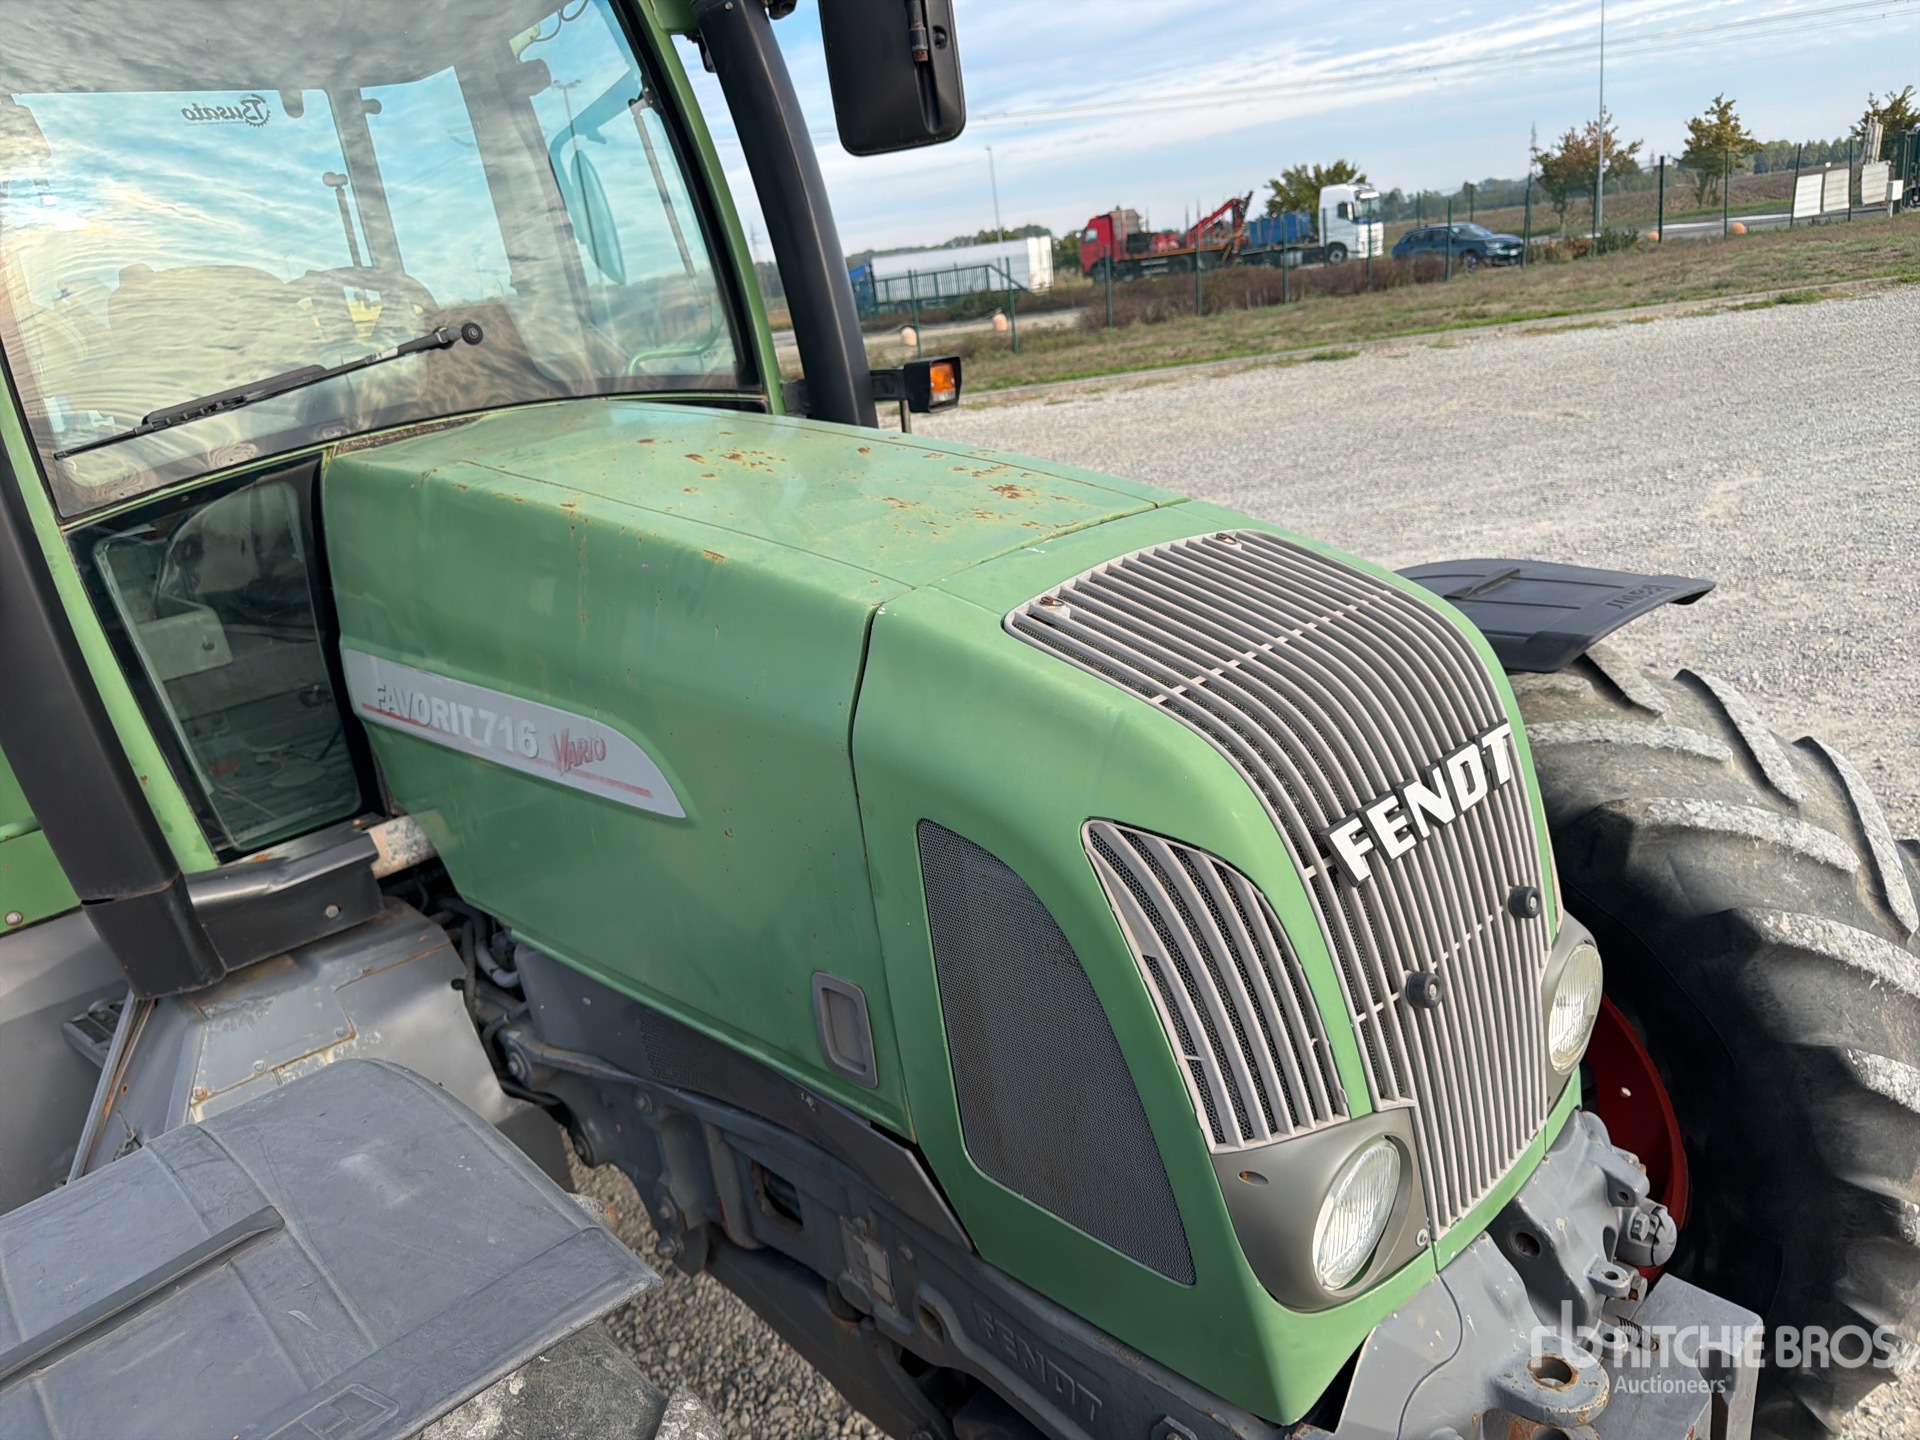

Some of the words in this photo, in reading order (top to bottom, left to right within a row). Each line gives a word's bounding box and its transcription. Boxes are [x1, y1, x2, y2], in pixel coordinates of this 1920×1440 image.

[375, 682, 474, 741] FAVORIT
[478, 708, 540, 760] 716
[1324, 719, 1512, 885] FENDT
[971, 1299, 1103, 1423] FENDT
